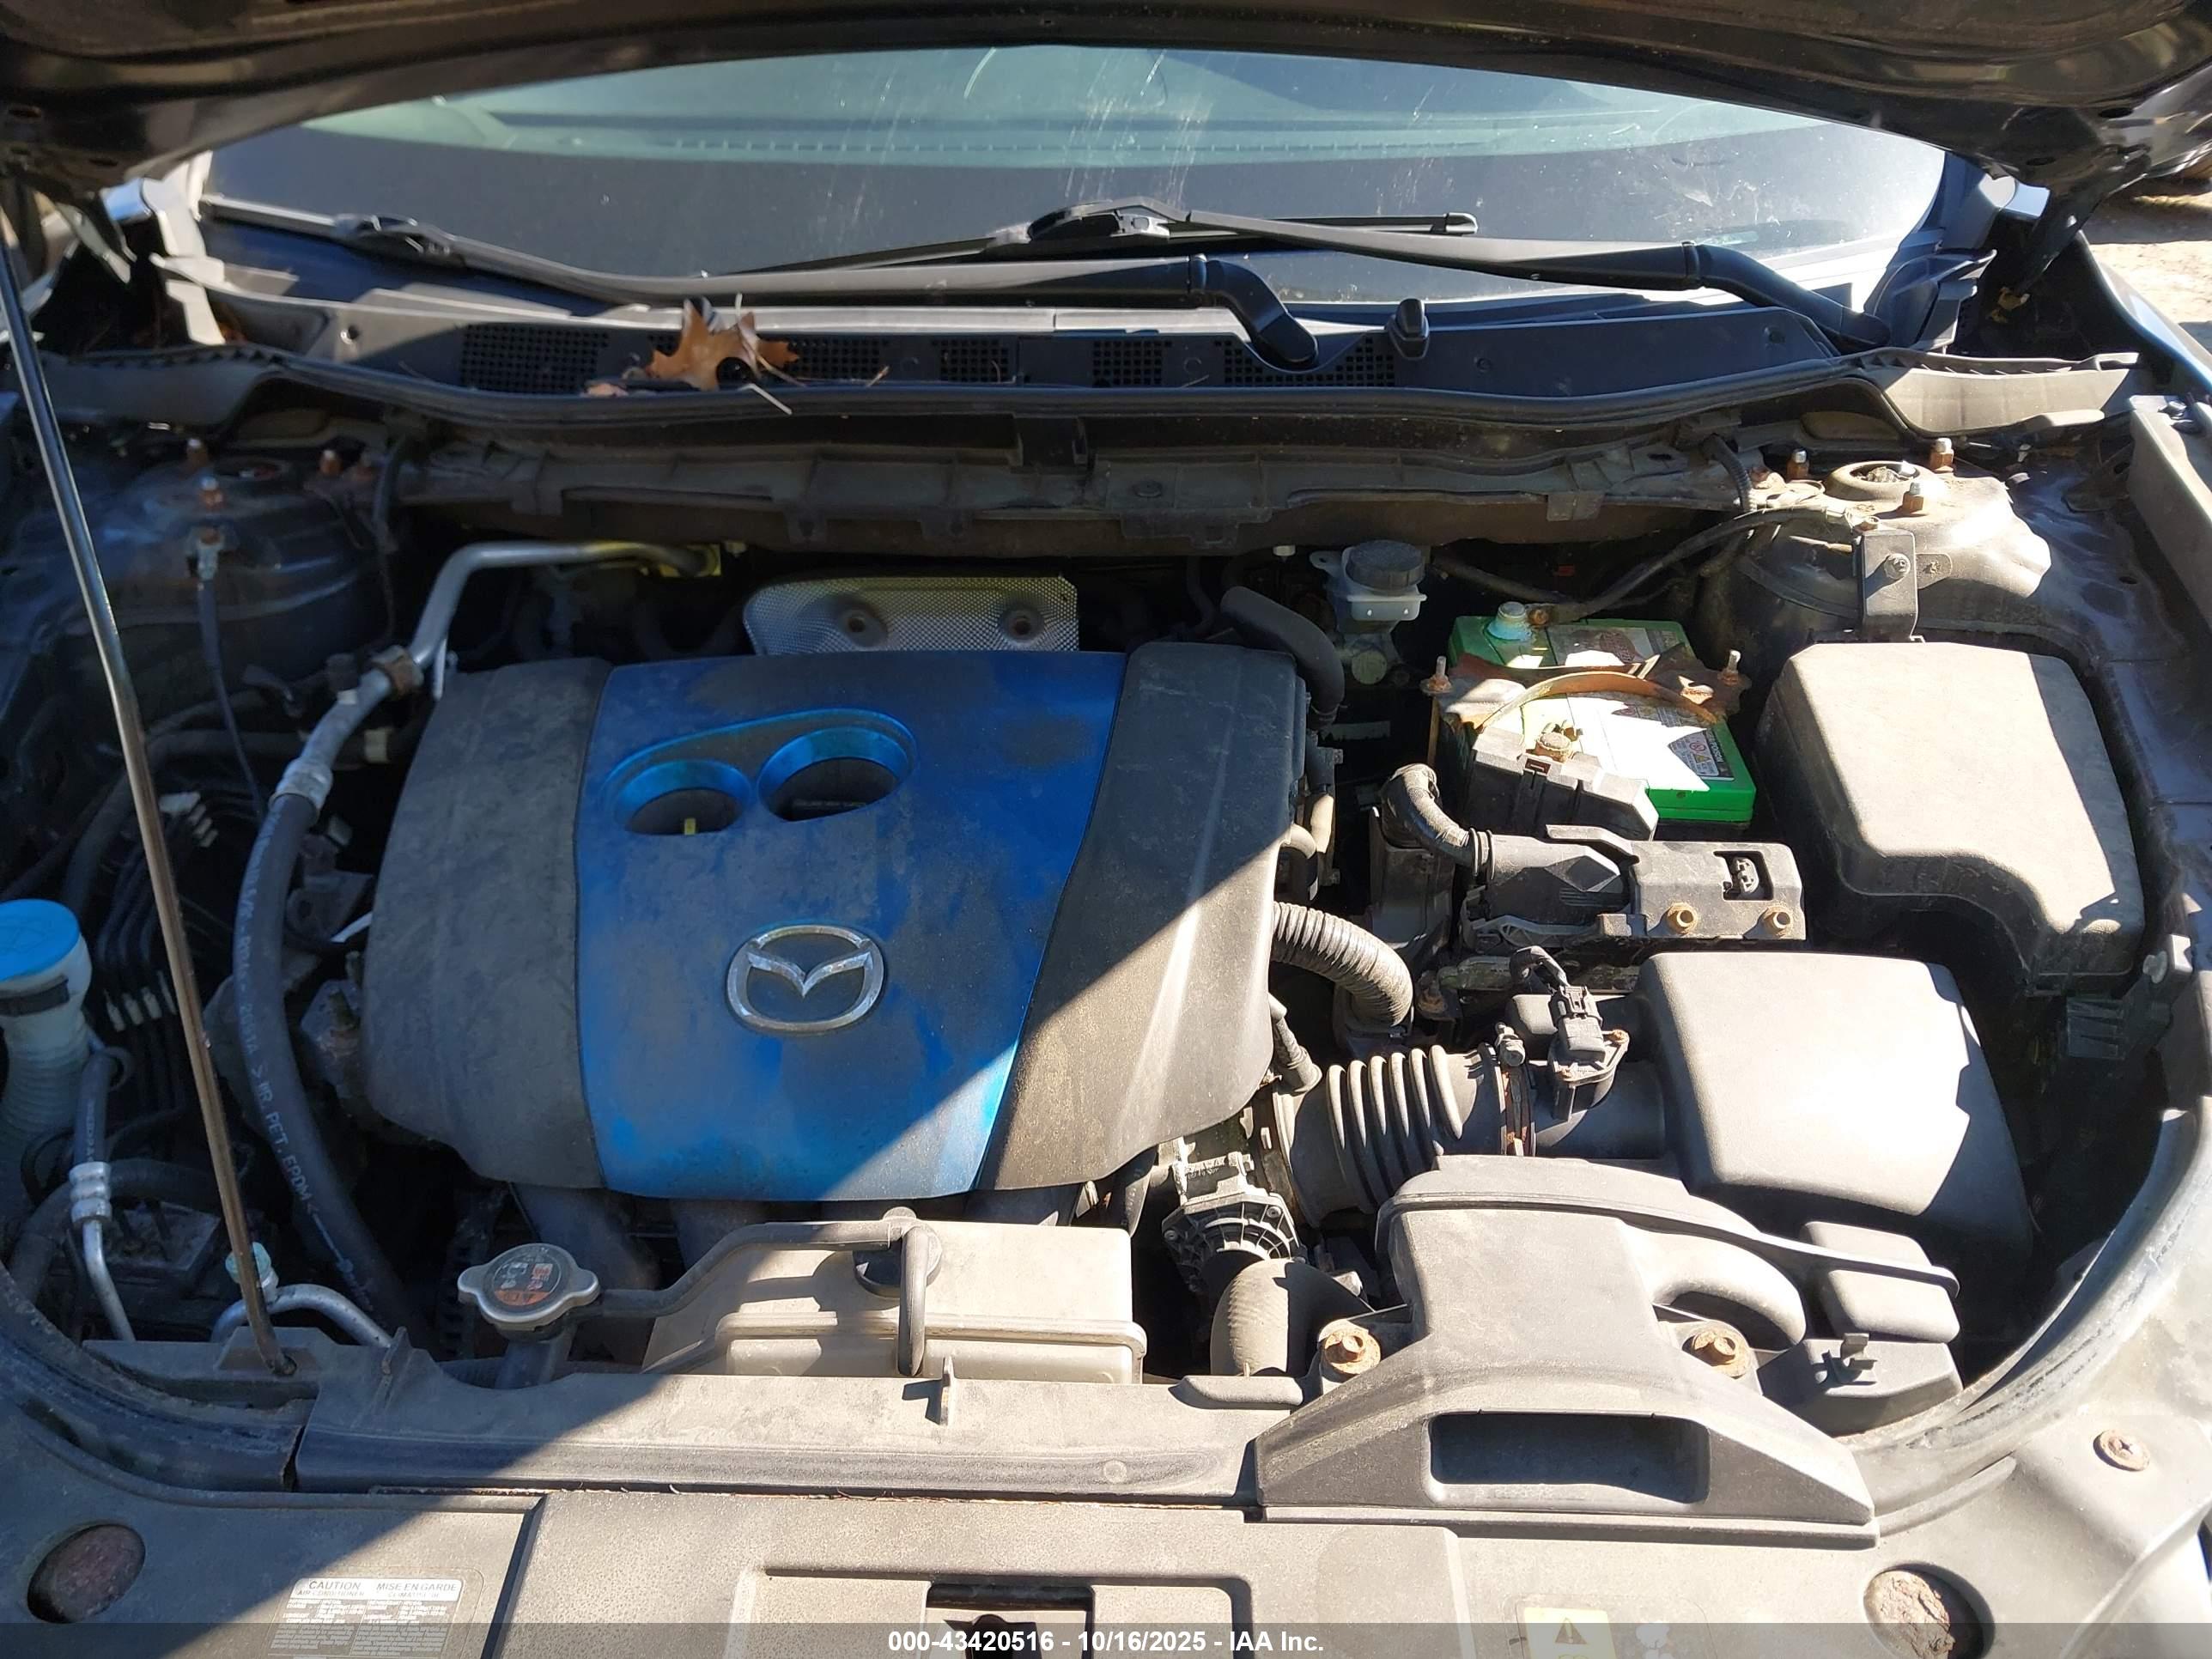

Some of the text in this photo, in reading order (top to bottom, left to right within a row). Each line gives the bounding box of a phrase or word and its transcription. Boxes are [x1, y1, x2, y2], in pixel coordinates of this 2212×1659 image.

[308, 1580, 362, 1589] CAUTION
[375, 1582, 402, 1590] MISE
[420, 1583, 458, 1591] GARDE
